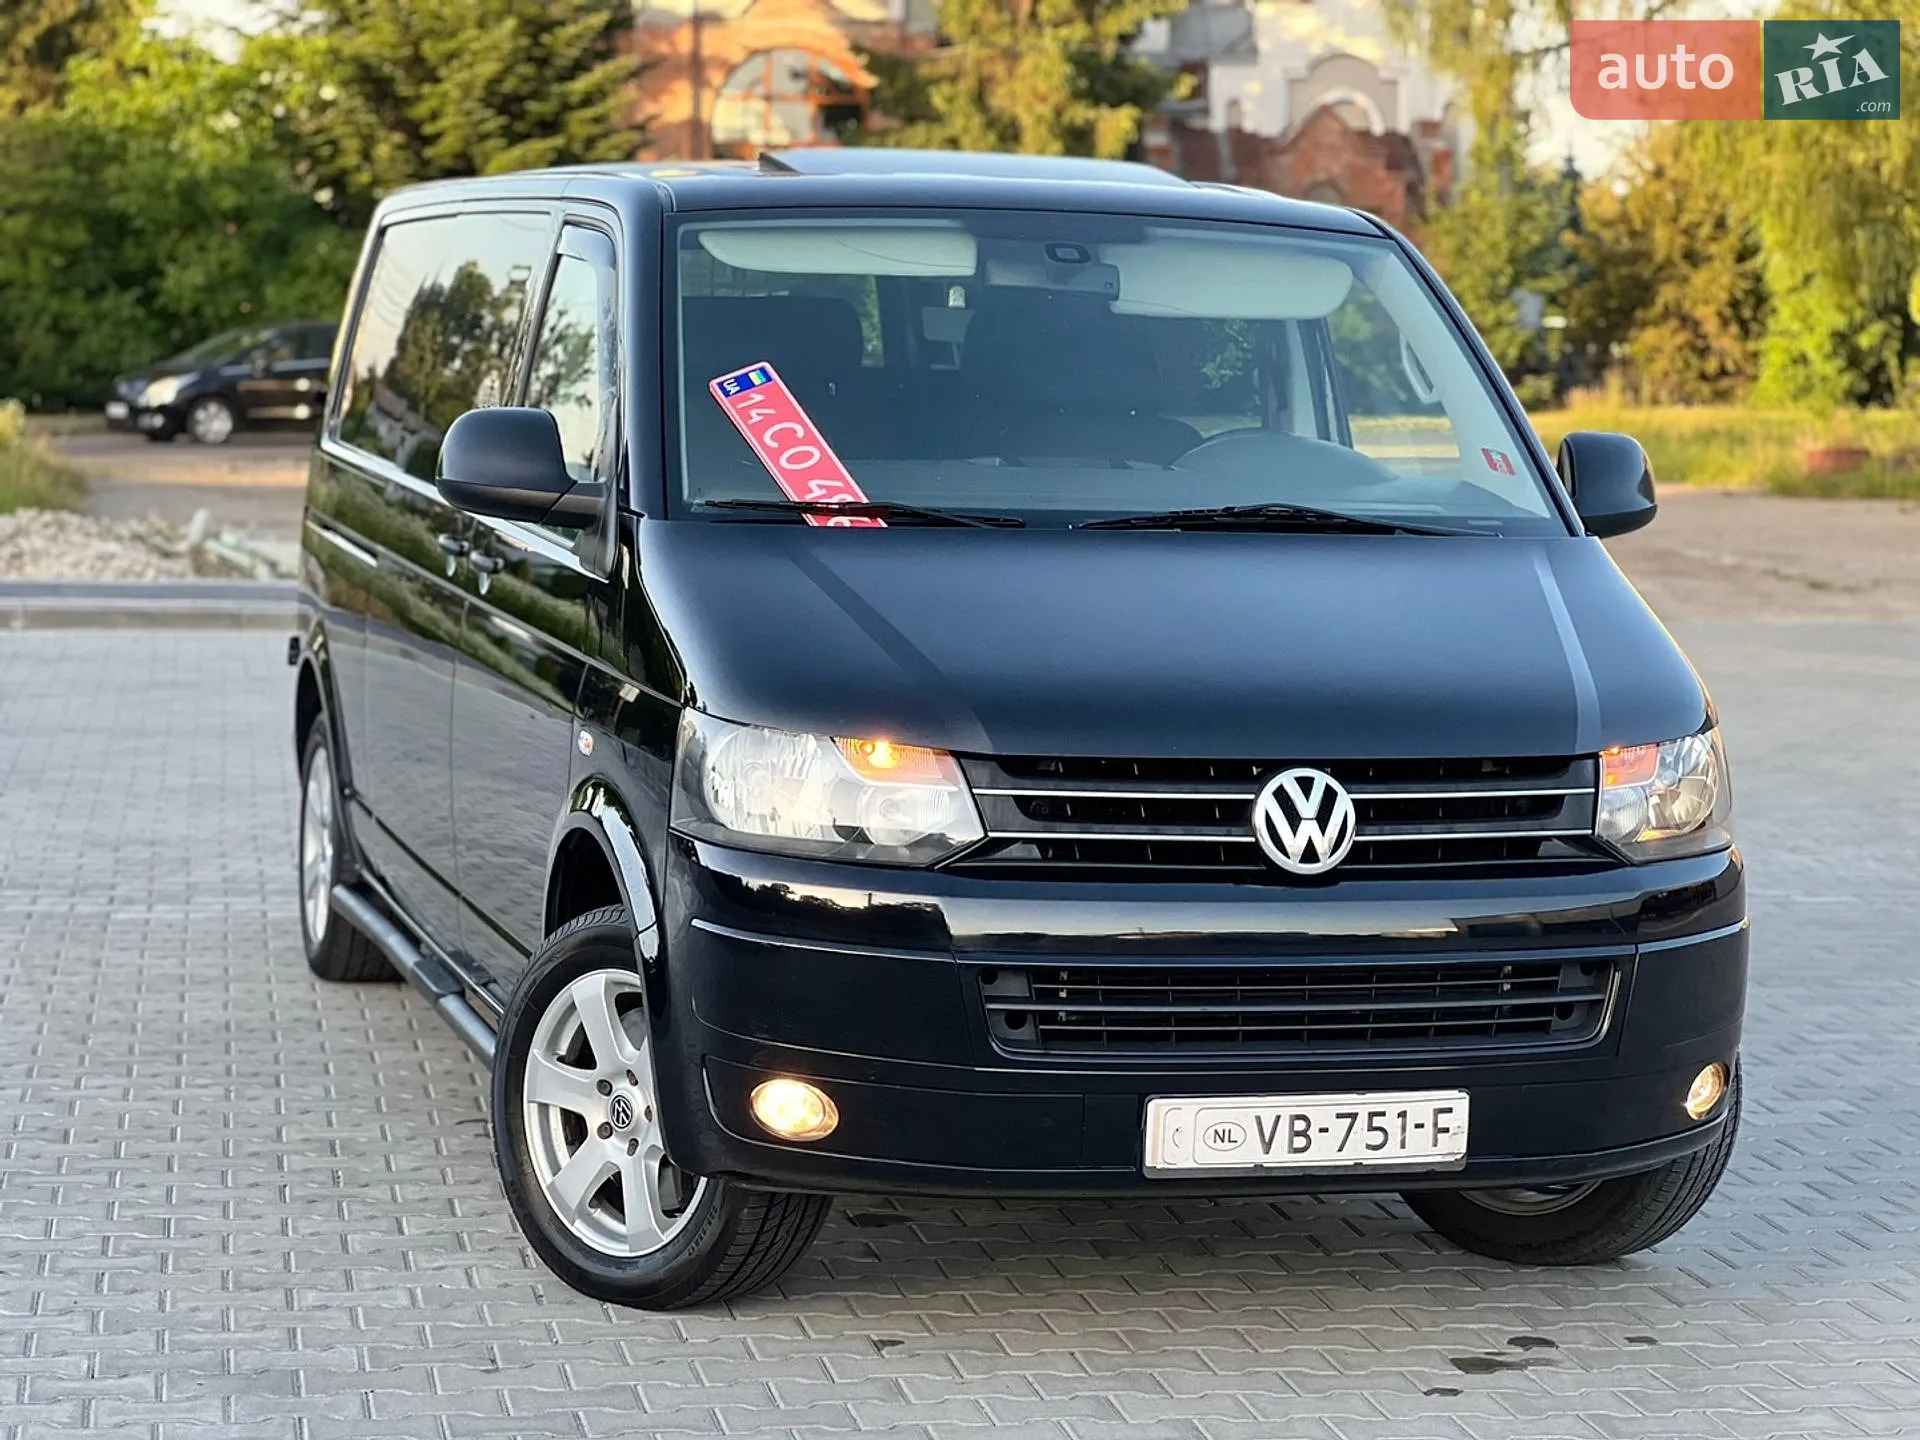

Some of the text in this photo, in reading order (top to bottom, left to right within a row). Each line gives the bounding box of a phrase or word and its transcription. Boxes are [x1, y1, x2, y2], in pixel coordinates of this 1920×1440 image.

[722, 378, 741, 396] UA
[1212, 1128, 1239, 1144] NL
[1254, 1106, 1455, 1156] VB-751-F
